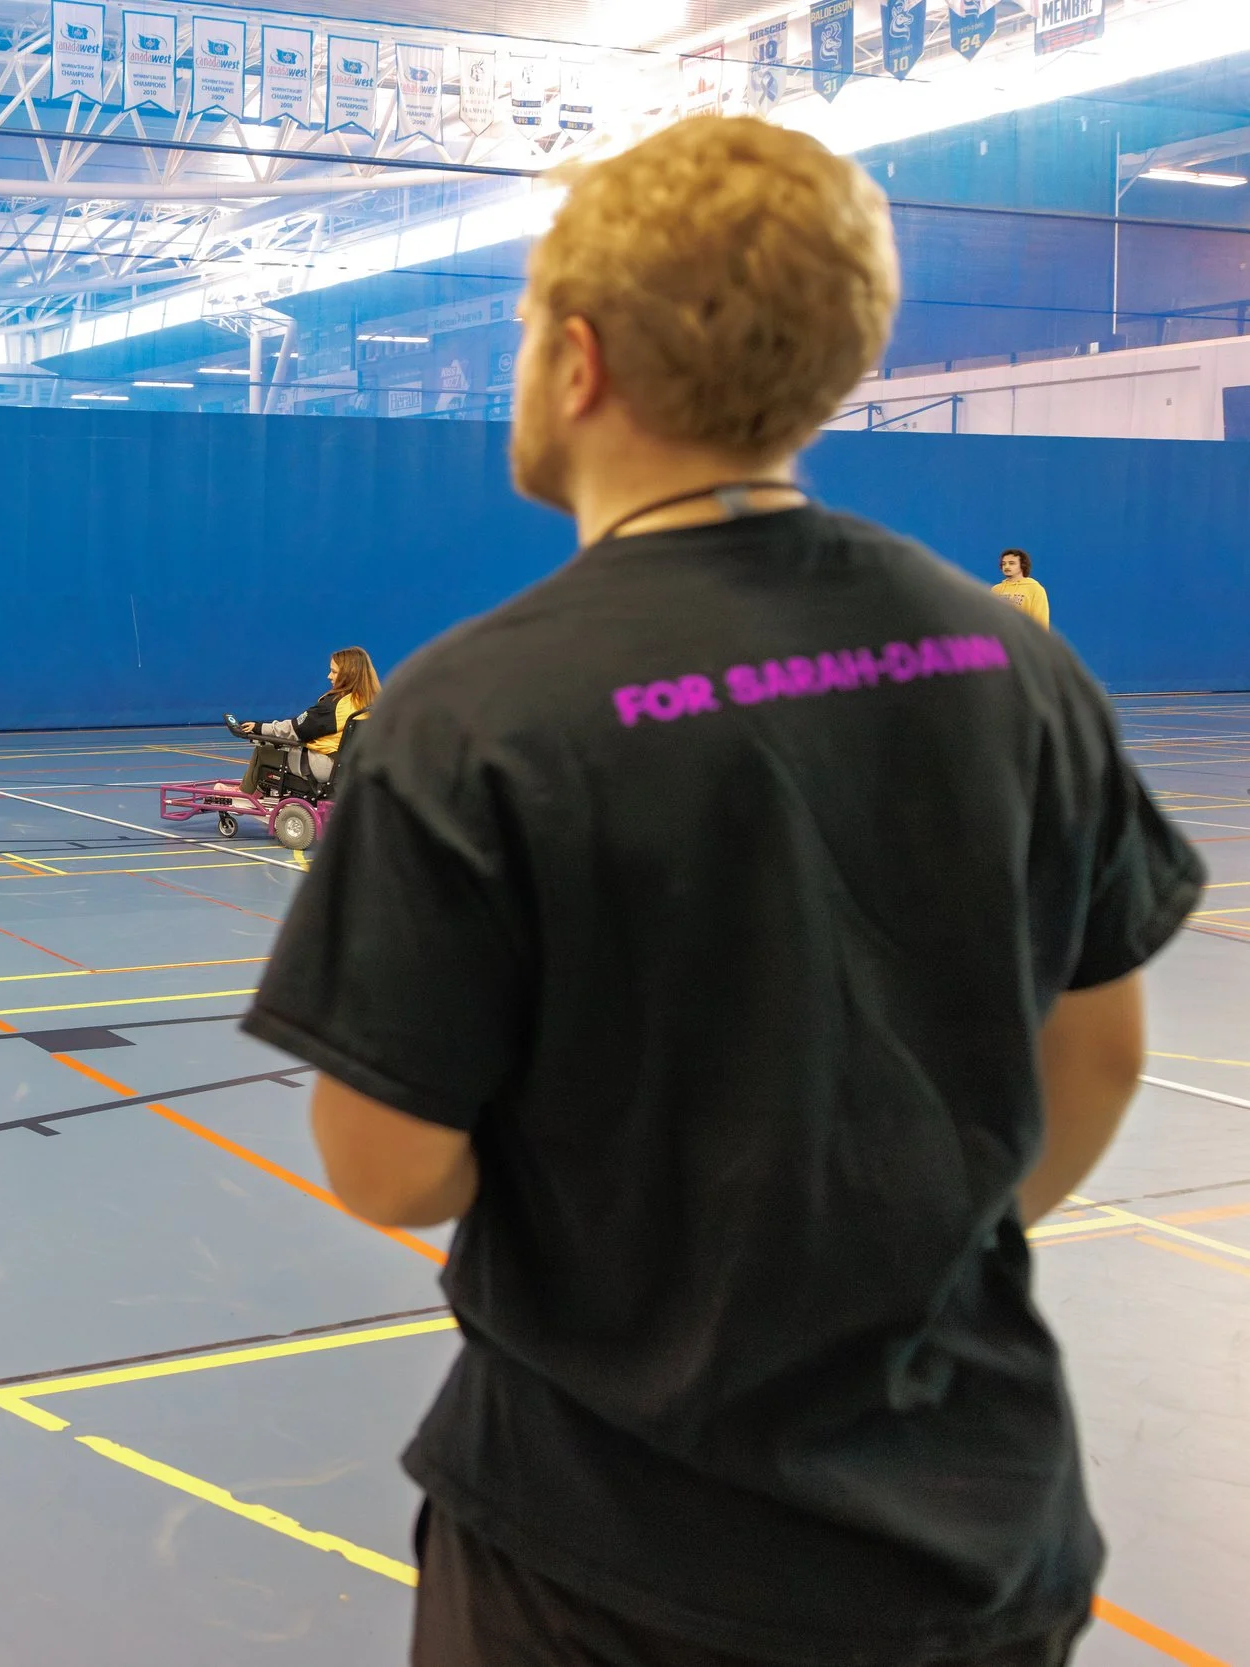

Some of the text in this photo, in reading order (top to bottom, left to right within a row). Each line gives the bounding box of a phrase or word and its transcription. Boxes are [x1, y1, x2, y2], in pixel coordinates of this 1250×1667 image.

[749, 21, 787, 41] HIRSCHE
[759, 41, 778, 61] 10
[960, 34, 981, 52] 24
[893, 56, 909, 73] 10
[61, 70, 94, 78] CHAMPIONS
[133, 80, 166, 88] CHAMPIONS
[823, 79, 837, 94] 31
[612, 674, 720, 726] FOR
